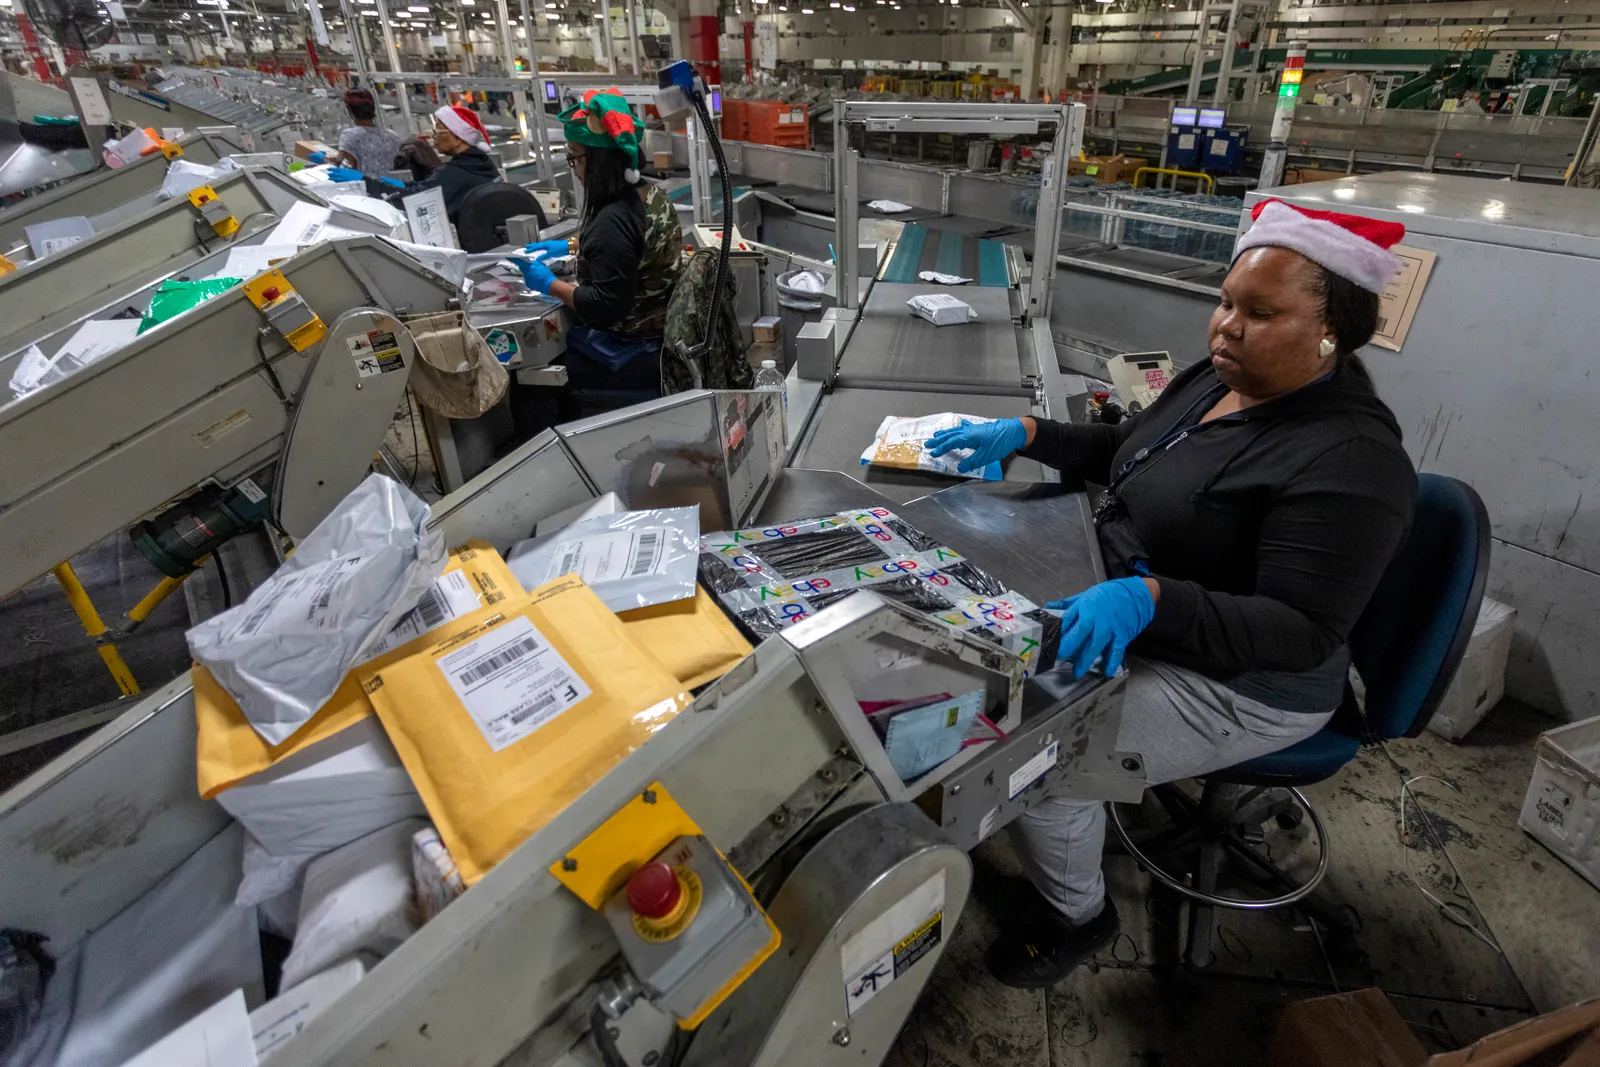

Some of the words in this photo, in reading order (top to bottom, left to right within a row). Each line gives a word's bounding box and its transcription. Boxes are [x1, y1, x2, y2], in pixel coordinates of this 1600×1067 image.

[734, 525, 798, 543] ebay
[348, 556, 361, 566] F
[854, 559, 918, 582] ebay
[761, 577, 832, 601] ebay
[533, 687, 554, 702] FIRST
[564, 684, 579, 702] F
[509, 699, 534, 715] CLASS
[1538, 796, 1565, 821] LABEL
[903, 912, 942, 946] WARNING
